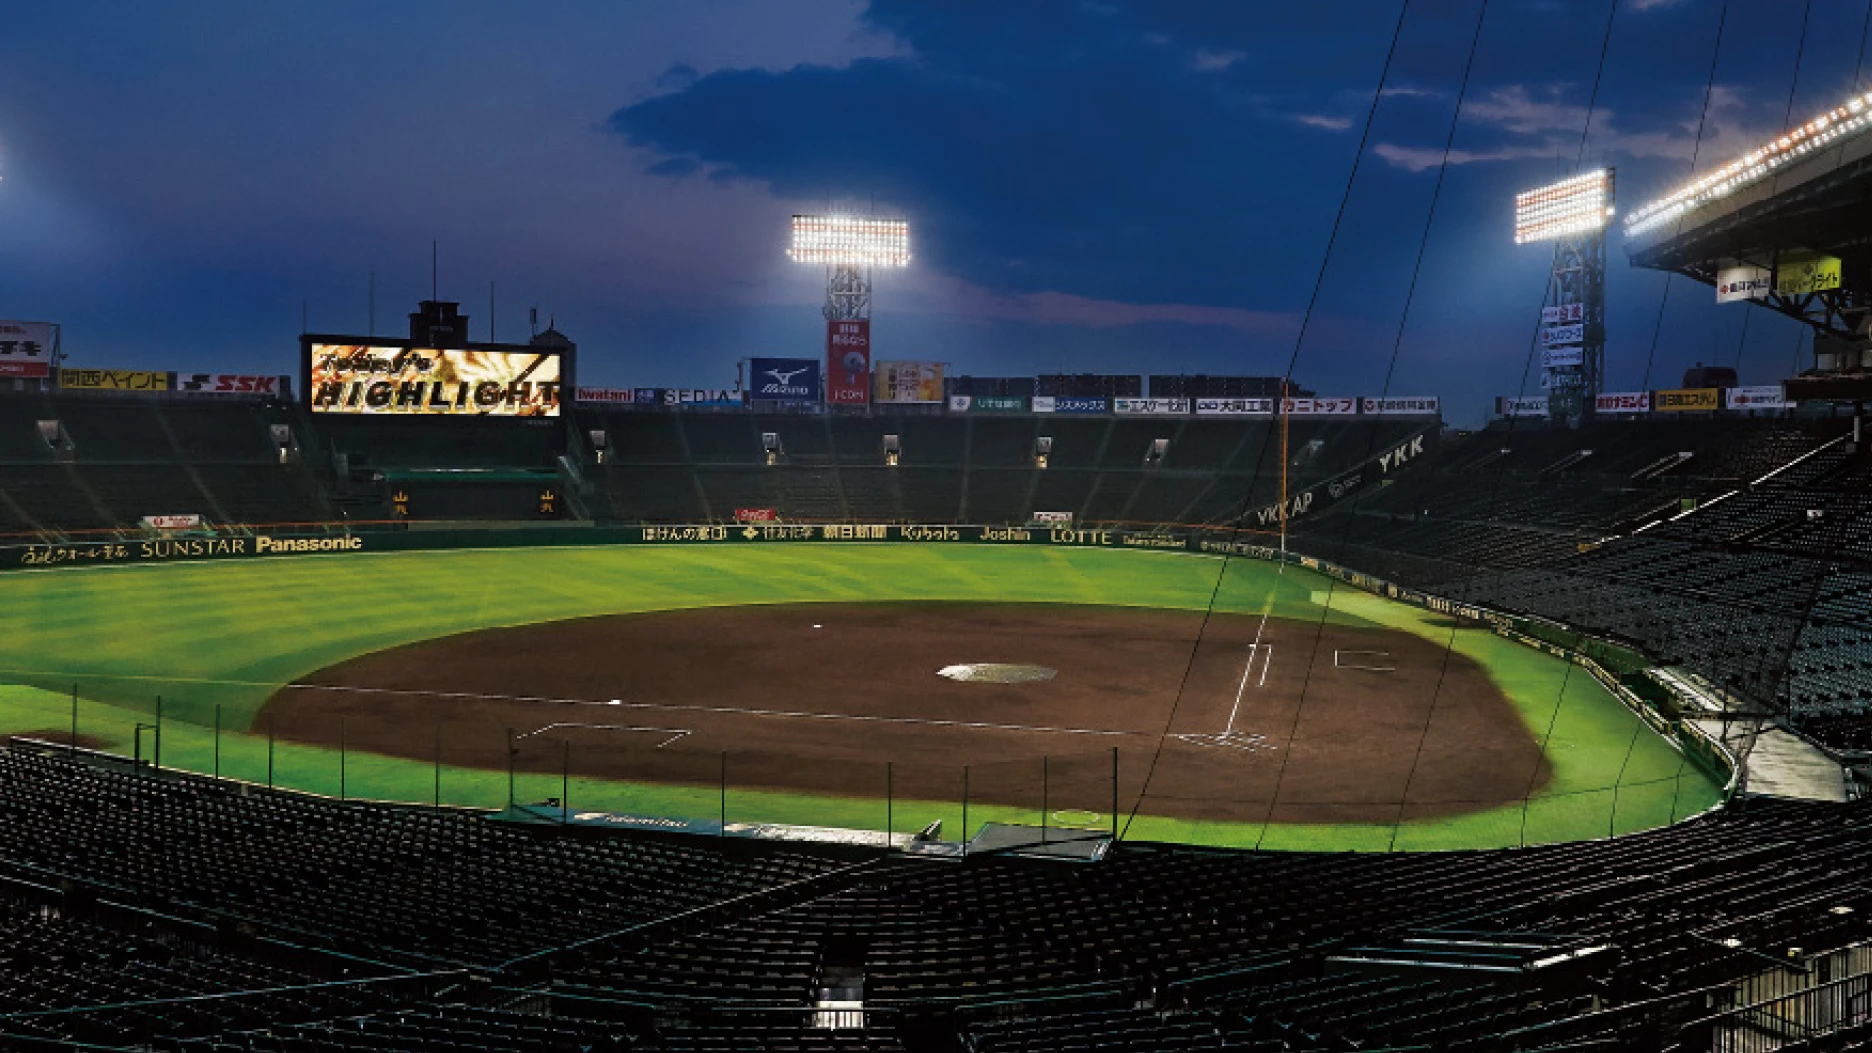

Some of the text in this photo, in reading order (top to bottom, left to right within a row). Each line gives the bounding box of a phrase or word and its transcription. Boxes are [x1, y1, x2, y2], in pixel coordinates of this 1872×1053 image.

[62, 371, 166, 388] 関西ペイント
[216, 375, 276, 391] SSK
[313, 381, 559, 407] HIGHLIGHT
[578, 389, 632, 402] Iwatani
[1220, 400, 1272, 412] 大同工業
[1379, 434, 1424, 473] YKK
[1292, 491, 1313, 518] AP
[642, 527, 727, 541] ほけんの窓口
[823, 525, 888, 539] 朝日新聞
[900, 525, 960, 541] Kubota
[979, 526, 1031, 541] Joshin
[1050, 529, 1113, 544] LOTTE
[141, 539, 245, 558] SUNSTAR
[255, 534, 362, 553] Panasonic
